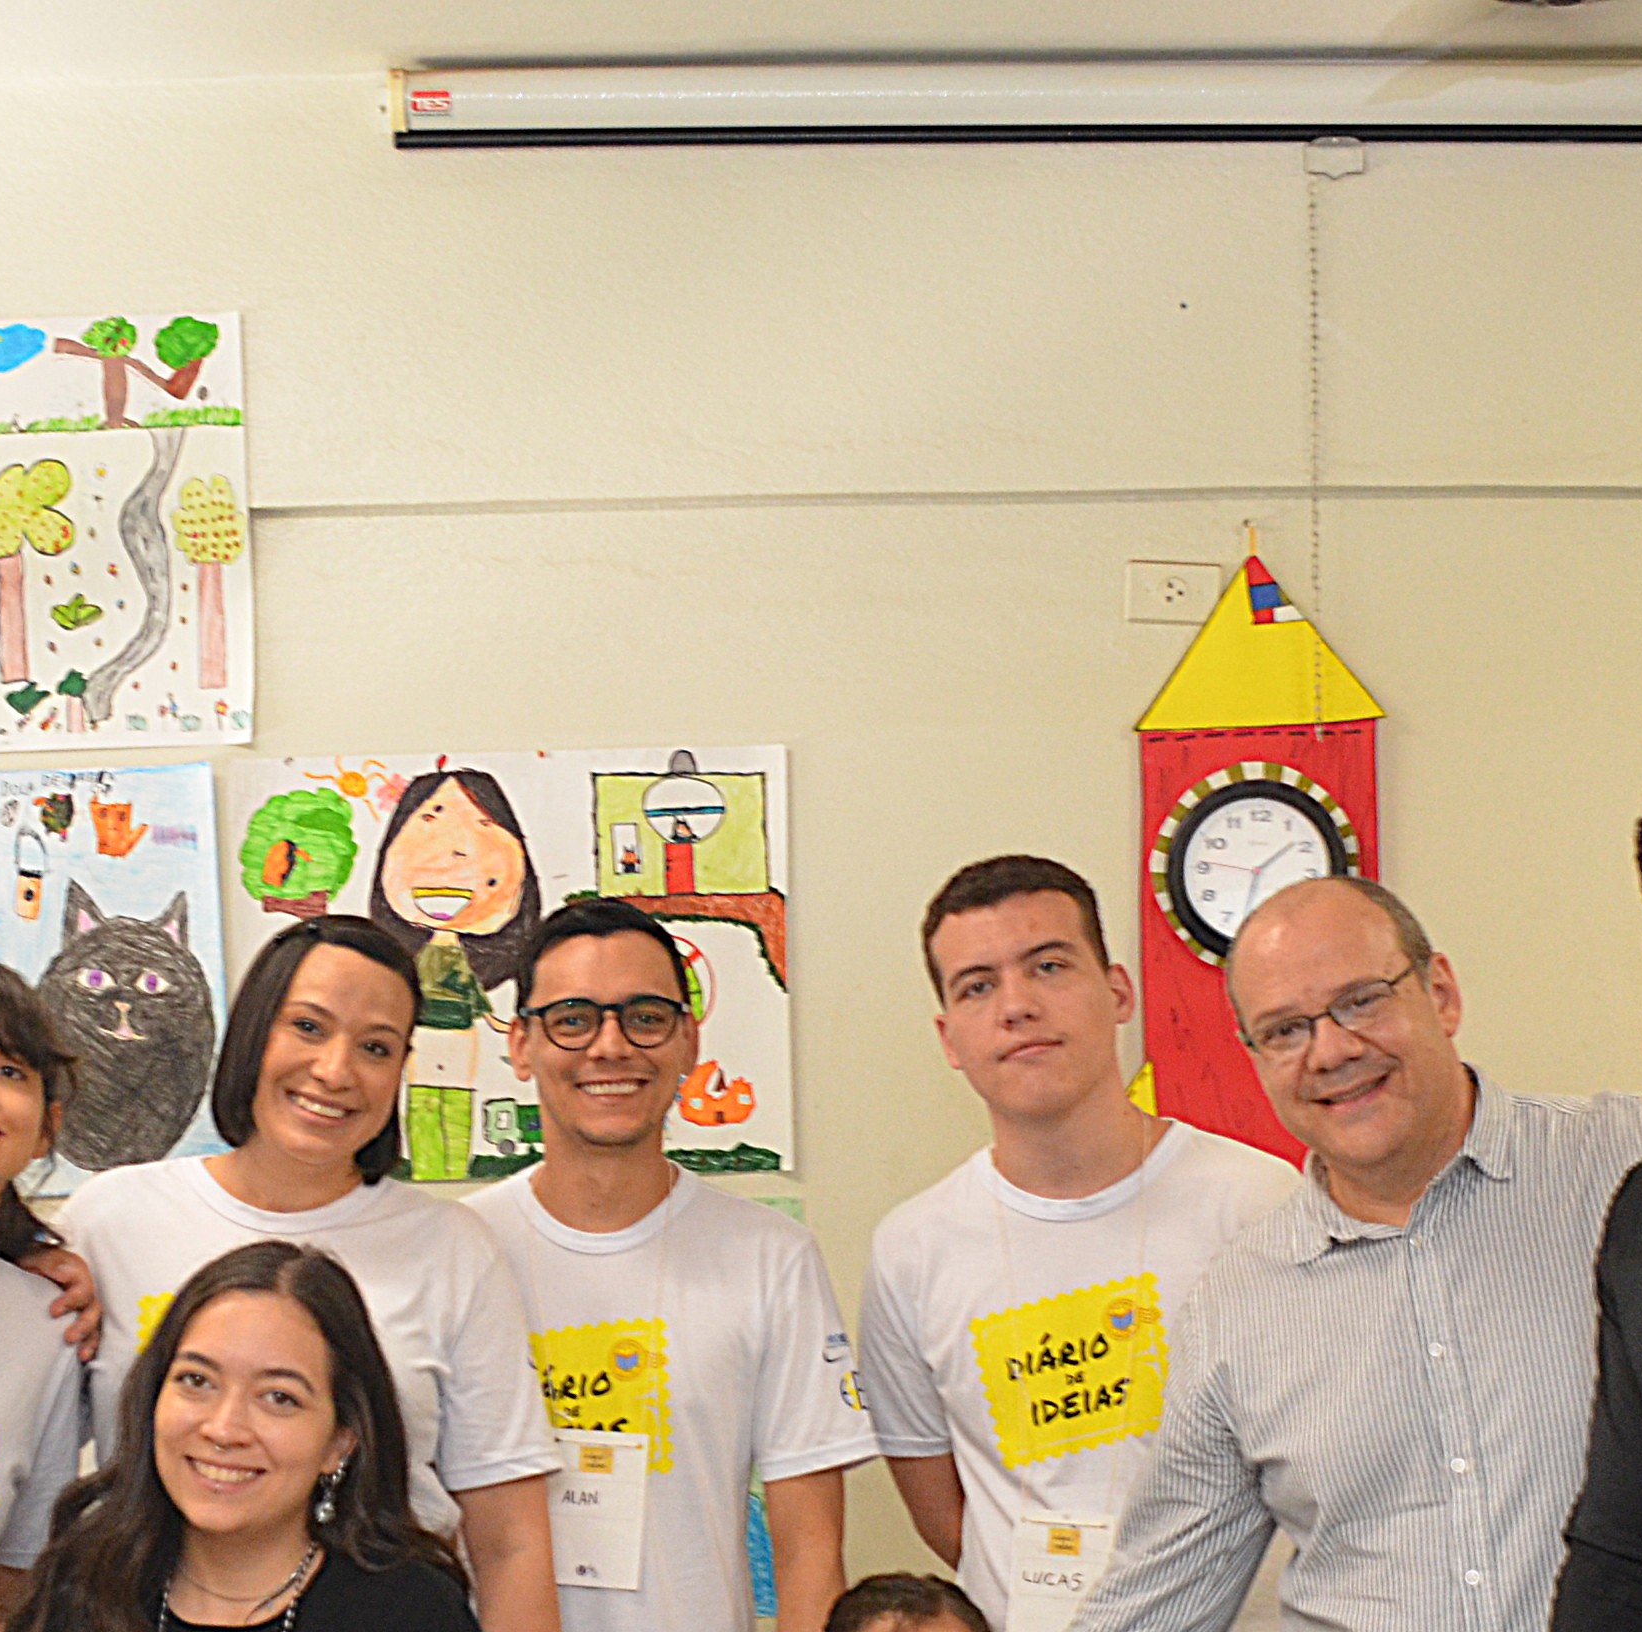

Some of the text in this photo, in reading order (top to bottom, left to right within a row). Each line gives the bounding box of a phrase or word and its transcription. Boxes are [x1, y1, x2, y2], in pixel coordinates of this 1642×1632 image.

[1250, 809, 1273, 823] 12
[1205, 837, 1227, 850] 10
[1299, 841, 1314, 854] 2
[1203, 889, 1216, 903] 8
[1220, 910, 1234, 923] 7
[1005, 1331, 1109, 1381] DIÁRIO
[1029, 1378, 1133, 1427] IDEIAS
[561, 1490, 600, 1506] ALAN
[1022, 1570, 1084, 1591] LUCAS
